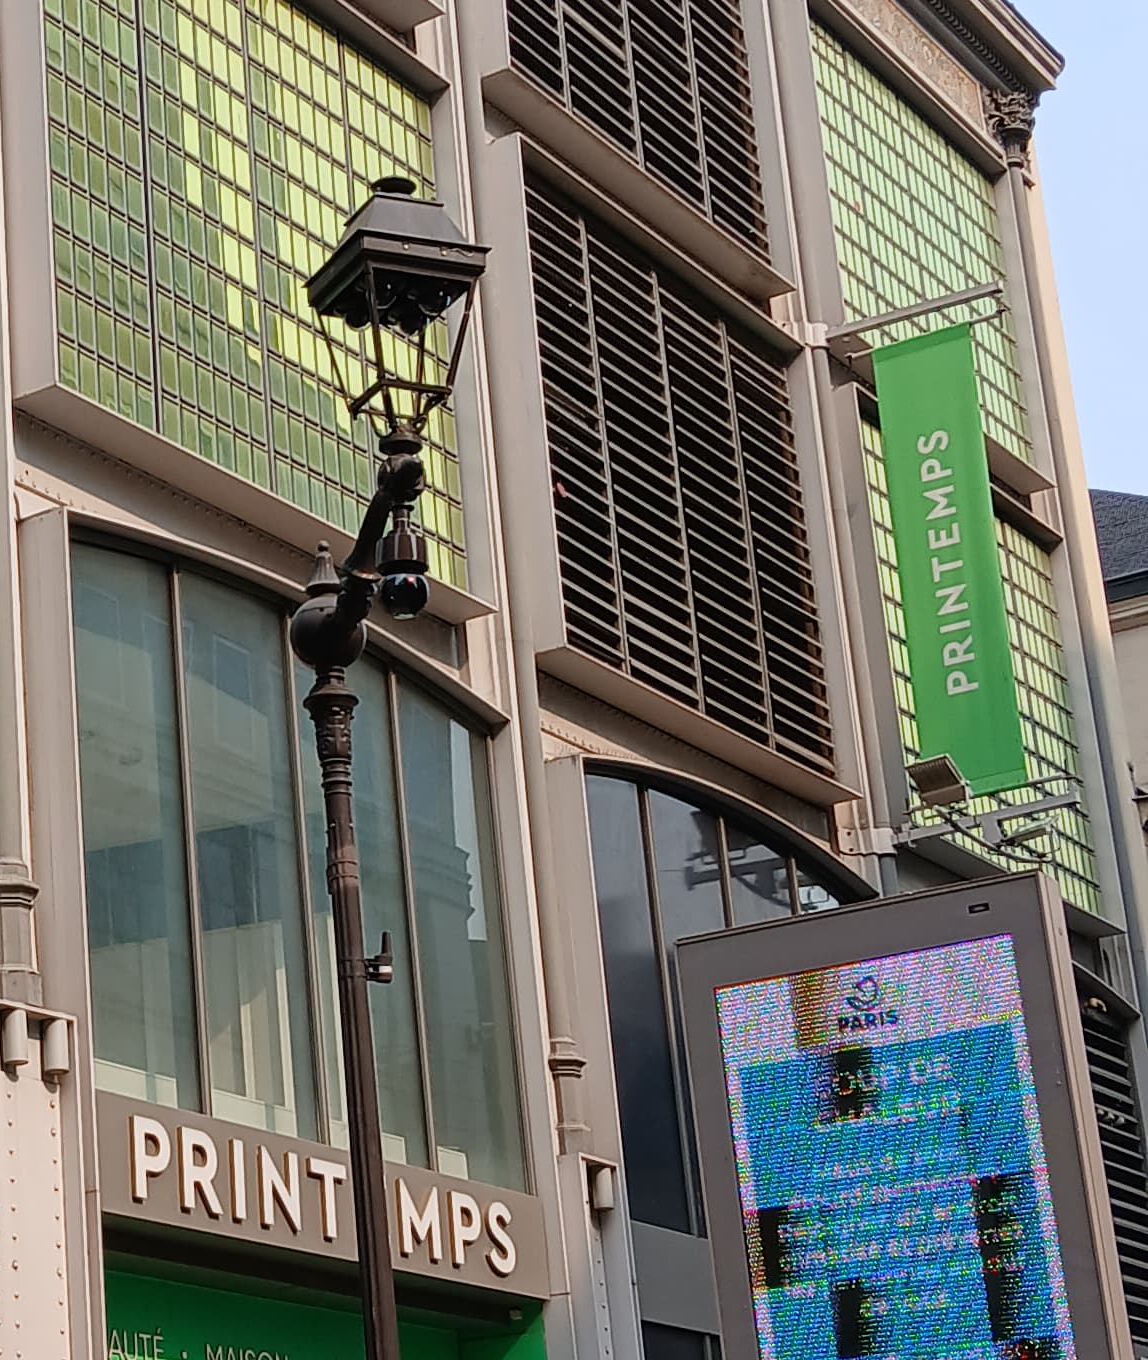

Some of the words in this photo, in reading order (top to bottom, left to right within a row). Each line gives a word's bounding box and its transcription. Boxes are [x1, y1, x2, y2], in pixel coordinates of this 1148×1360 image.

[917, 429, 980, 696] PRINTEMPS
[838, 1008, 899, 1035] PARIS
[128, 1114, 516, 1278] PRINTMPS
